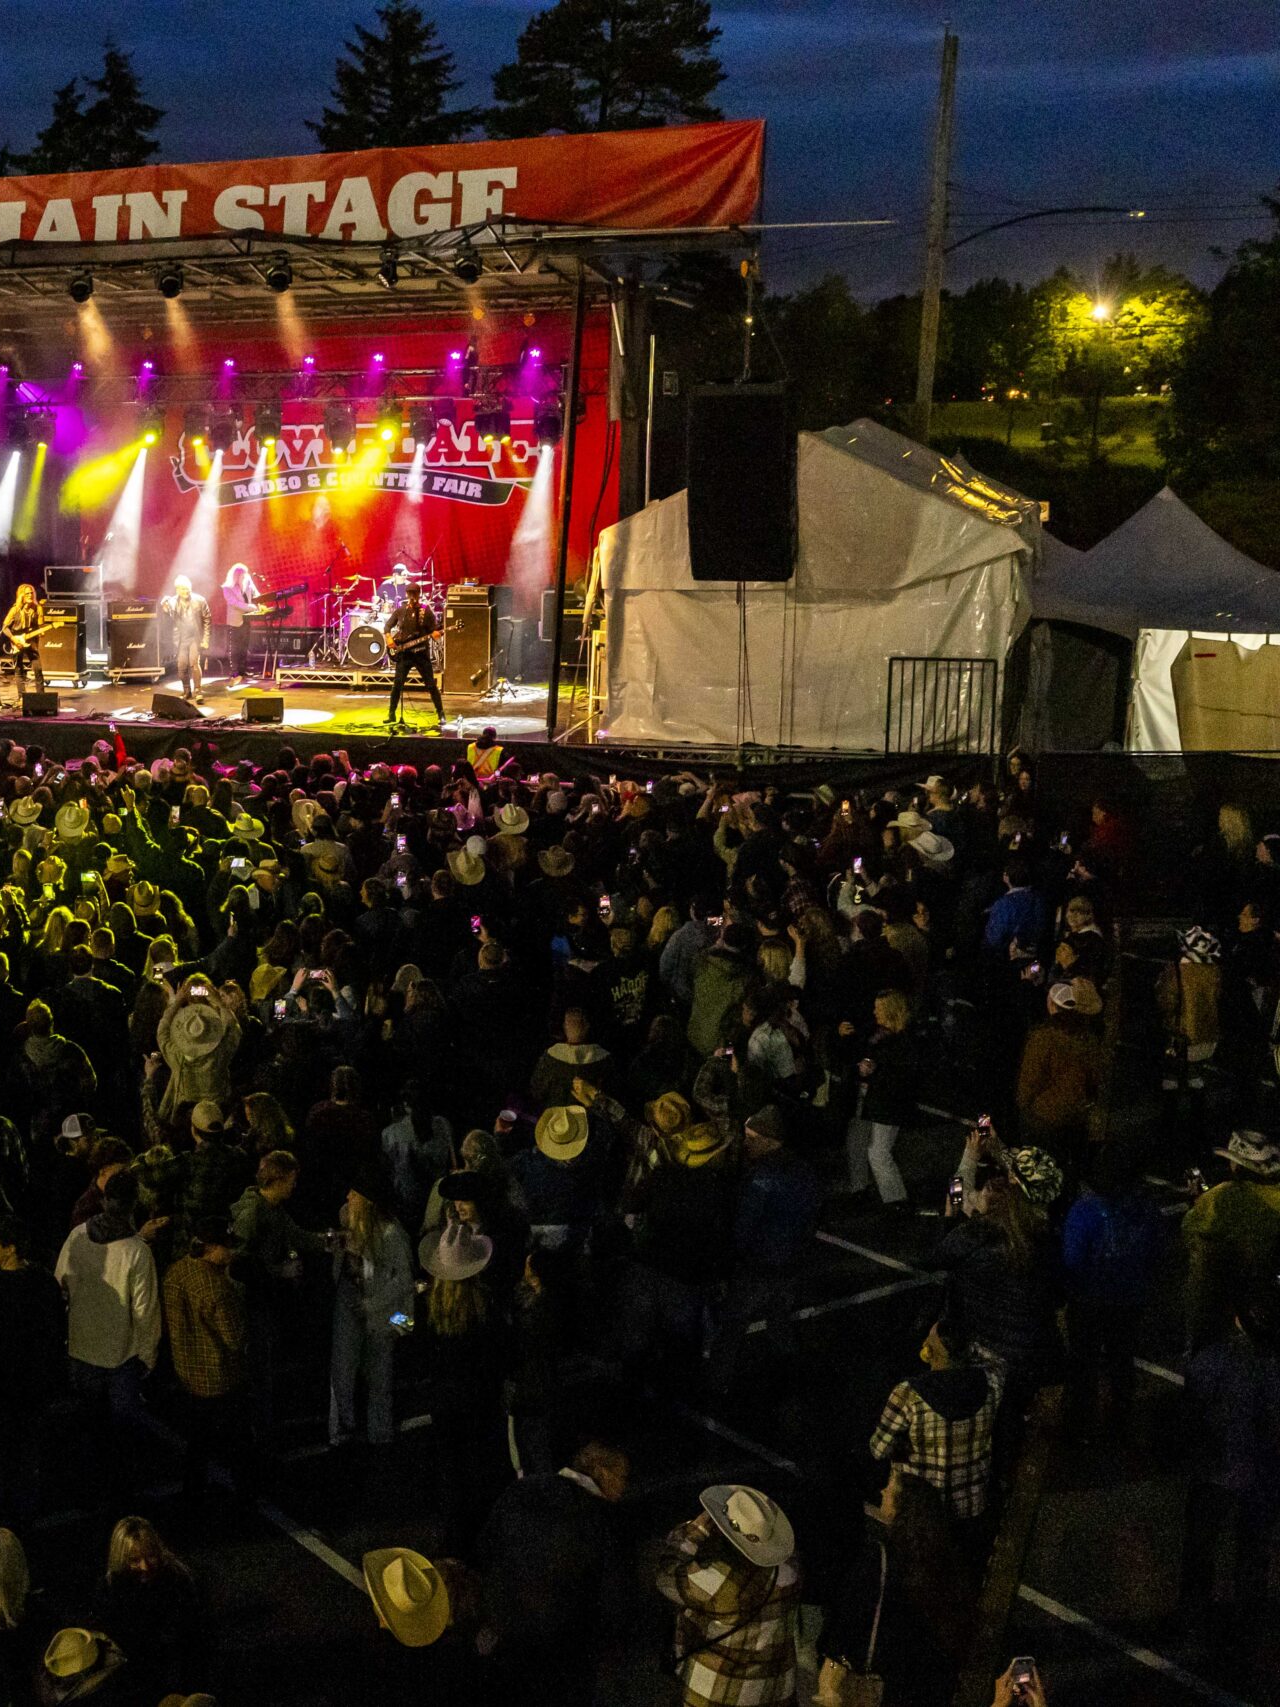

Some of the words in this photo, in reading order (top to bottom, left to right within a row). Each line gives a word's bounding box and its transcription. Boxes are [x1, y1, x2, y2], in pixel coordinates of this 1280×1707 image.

[214, 167, 519, 241] STAGE
[178, 418, 552, 486] CLOVRDALE
[233, 475, 301, 499] RODEO
[307, 473, 321, 488] &
[326, 471, 428, 489] CNTRY
[431, 476, 483, 499] FAIR
